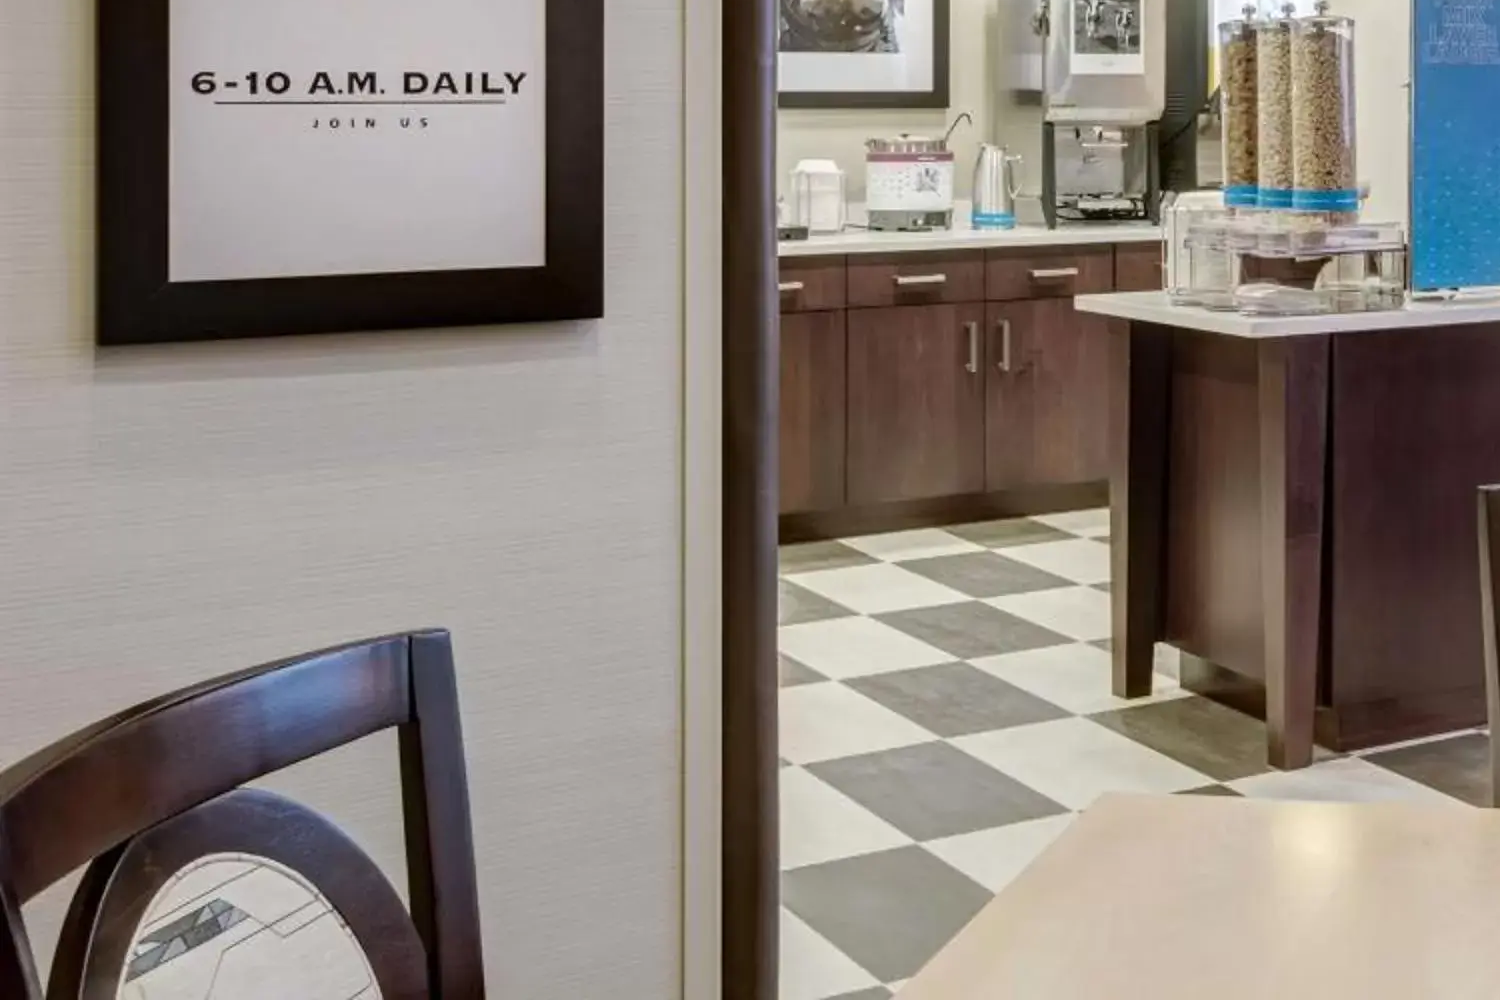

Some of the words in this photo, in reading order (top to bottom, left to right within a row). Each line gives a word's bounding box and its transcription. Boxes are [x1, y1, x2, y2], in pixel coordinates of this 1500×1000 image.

[191, 71, 291, 95] 6-10
[308, 71, 386, 95] A.M.
[402, 71, 527, 95] DAILY
[312, 117, 376, 129] JOIN
[399, 117, 429, 129] US
